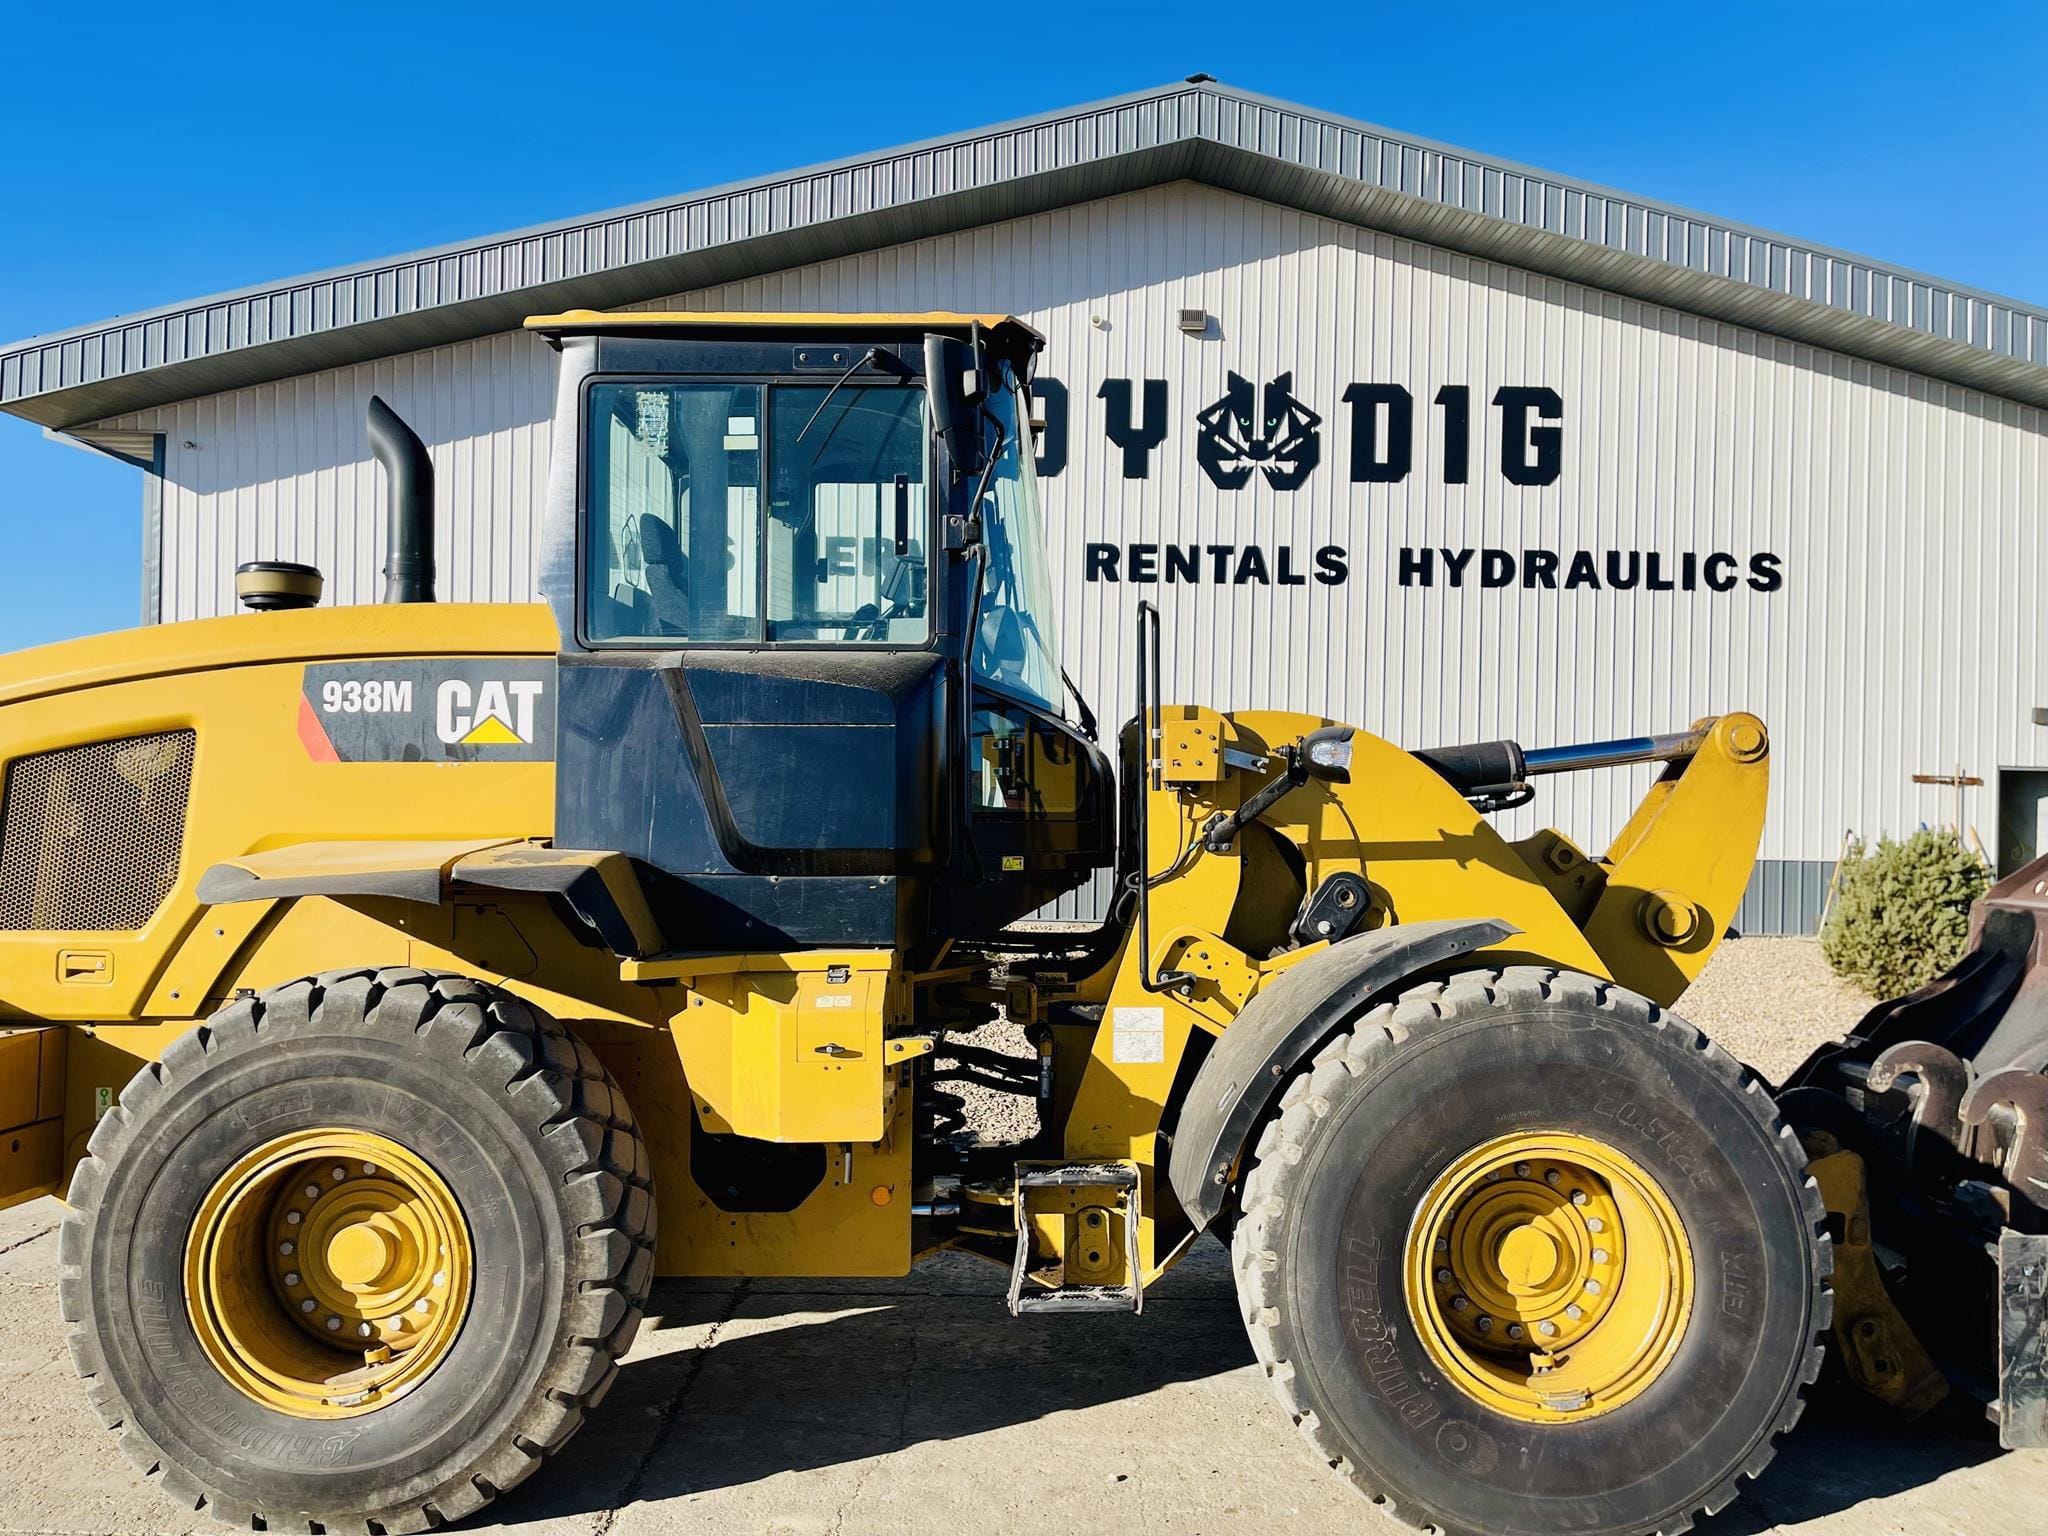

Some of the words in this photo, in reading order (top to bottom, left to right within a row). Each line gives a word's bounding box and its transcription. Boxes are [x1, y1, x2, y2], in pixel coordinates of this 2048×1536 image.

[1341, 382, 1564, 487] DIG
[1085, 541, 1348, 586] RENTALS
[1399, 546, 1783, 592] HYDRAULICS
[322, 680, 412, 713] 938M
[436, 679, 543, 744] CAT
[137, 1279, 361, 1466] BRIDGESTONE
[1347, 1236, 1441, 1432] PURCELL
